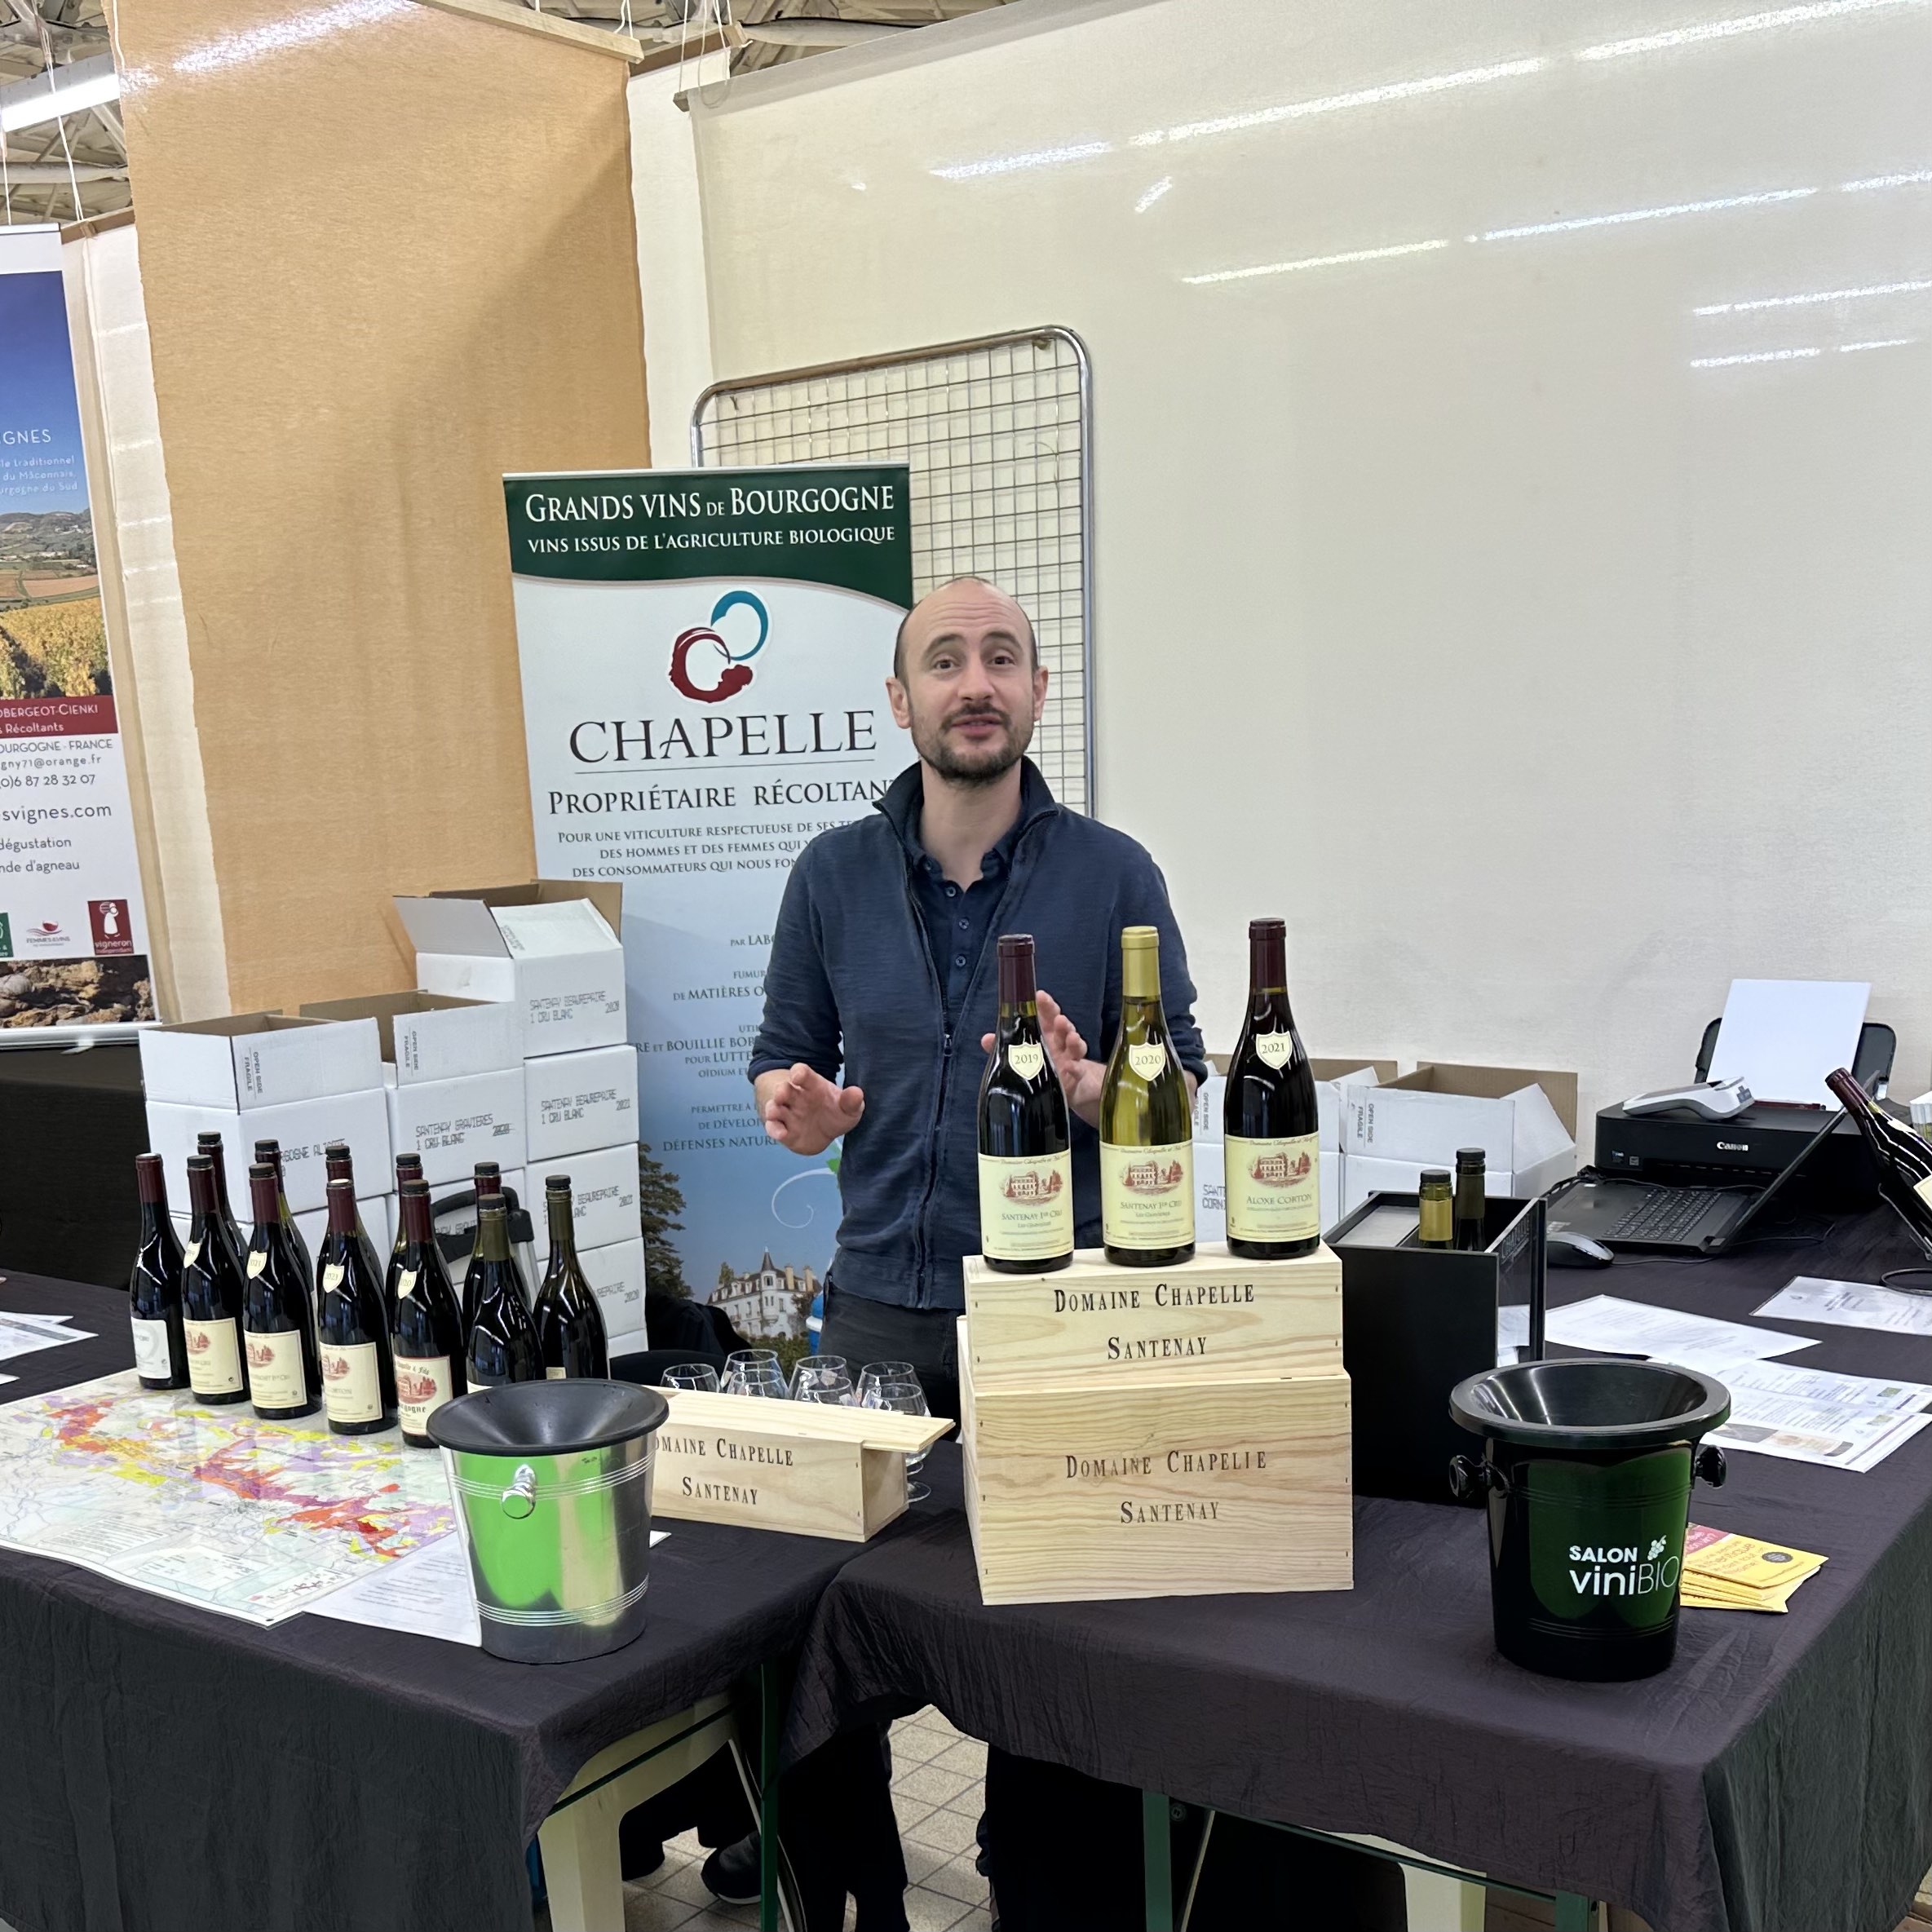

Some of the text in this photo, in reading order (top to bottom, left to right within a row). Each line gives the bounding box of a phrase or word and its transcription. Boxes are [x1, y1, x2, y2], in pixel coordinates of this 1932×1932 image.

[525, 485, 895, 522] GRANDS VINS DE BOURGOGNE
[528, 526, 895, 553] VINS ISSUS DE L'AGRICULTURE BIOLOGIQUE
[5, 722, 64, 733] Récoltants
[569, 710, 877, 763] CHAPELLE
[69, 739, 113, 750] FRANCE
[25, 775, 40, 787] 87
[43, 774, 59, 785] 28
[62, 774, 77, 786] 32
[80, 774, 96, 785] 07
[548, 779, 895, 815] PROPRIÉTAIRE RÉCOLTAN
[558, 832, 593, 843] POUR
[595, 831, 621, 842] UNE
[624, 827, 703, 840] VITICULTURE
[706, 823, 794, 837] RESPECTUEUSE
[797, 822, 813, 833] DE
[816, 821, 835, 832] SES
[599, 840, 801, 859] DES HOMMES ET DES FEMMES QUI
[25, 860, 80, 874] d'agneau
[573, 868, 595, 878] DES
[598, 862, 707, 877] CONSOMMATEURS
[710, 860, 733, 873] QUI
[736, 859, 771, 869] NOUS
[95, 939, 132, 950] vigneron
[673, 992, 686, 1001] DE
[688, 985, 750, 1000] MATIÈRES
[666, 1037, 726, 1051] BOUILLIE
[1262, 1042, 1286, 1054] 2021
[685, 1055, 711, 1064] POUR
[1015, 1053, 1039, 1065] 2019
[1134, 1054, 1162, 1066] 2020
[691, 1103, 742, 1114] PERMETTRE
[698, 1122, 710, 1130] DE
[663, 1138, 725, 1152] DÉFENSES
[1716, 1141, 1749, 1152] Canon
[1120, 1201, 1157, 1210] SANTENAY
[1246, 1193, 1311, 1205] ALOXE CORTON
[1001, 1213, 1038, 1221] SANTENAY
[1054, 1283, 1255, 1314] DOMAINE CHAPELLE
[1107, 1335, 1208, 1360] SANTENAY
[716, 1438, 794, 1467] CHAPELLE
[1065, 1454, 1153, 1479] DOMAINE
[682, 1476, 758, 1506] SANTENAY
[1120, 1501, 1220, 1525] SANTENAY
[1569, 1545, 1638, 1563] SALON
[1569, 1555, 1680, 1596] viniBIO
